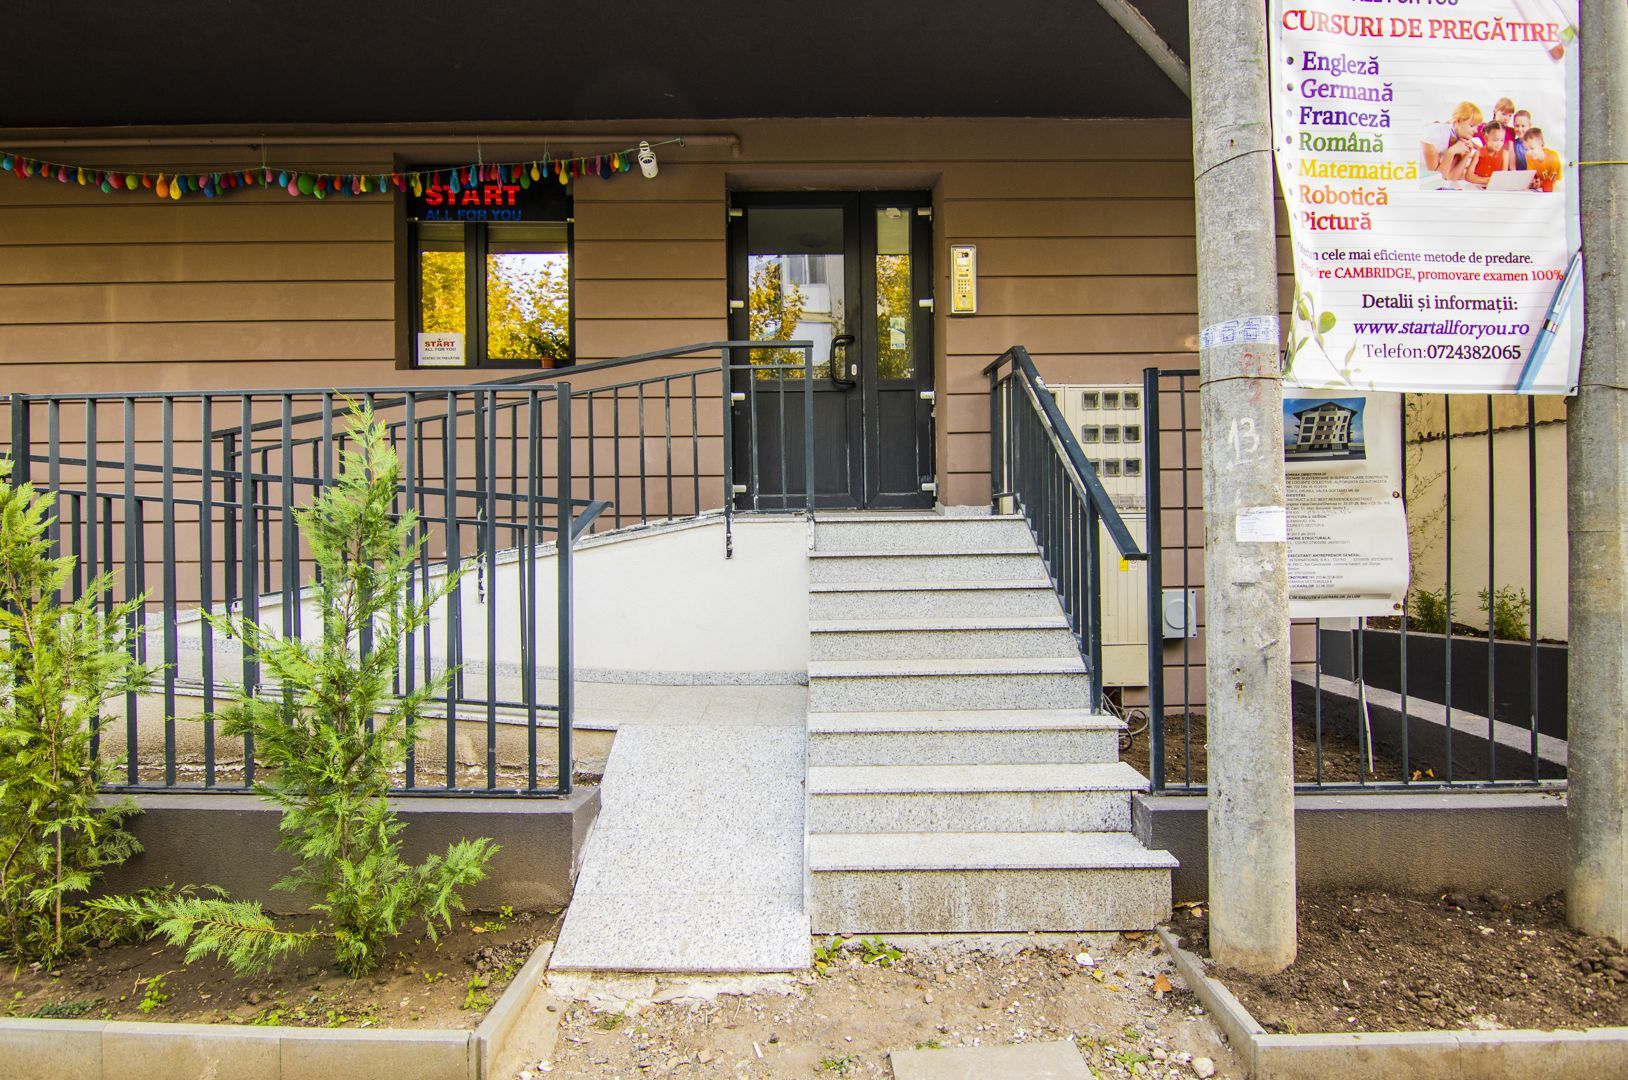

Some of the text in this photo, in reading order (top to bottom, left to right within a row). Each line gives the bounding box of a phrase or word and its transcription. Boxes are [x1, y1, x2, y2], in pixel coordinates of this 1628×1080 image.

[1282, 10, 1560, 42] CURSURI DE PREGĂTIRE
[1302, 51, 1379, 77] Engleză
[1301, 78, 1393, 102] Germană
[1299, 106, 1390, 128] Franceză
[1299, 132, 1384, 153] Română
[1299, 159, 1417, 180] Matematică
[425, 185, 520, 205] START
[1299, 184, 1388, 206] Robotică
[425, 209, 523, 221] ALL FOR YOU
[1300, 212, 1372, 230] Pictură
[1322, 249, 1346, 260] cele
[1349, 250, 1371, 261] mai
[1374, 251, 1421, 262] eficiente
[1424, 252, 1465, 263] metode
[1468, 253, 1482, 264] de
[1485, 253, 1533, 267] predare.
[1335, 268, 1415, 282] CAMBRIDGE,
[1418, 271, 1480, 283] promovare
[1483, 272, 1528, 281] examen
[1531, 271, 1563, 281] 100%
[1362, 294, 1518, 313] Detalii și informații:
[1353, 321, 1529, 339] www.startallforyou.ro
[1363, 344, 1521, 359] Telefon:0724382065
[1228, 417, 1260, 459] 13
